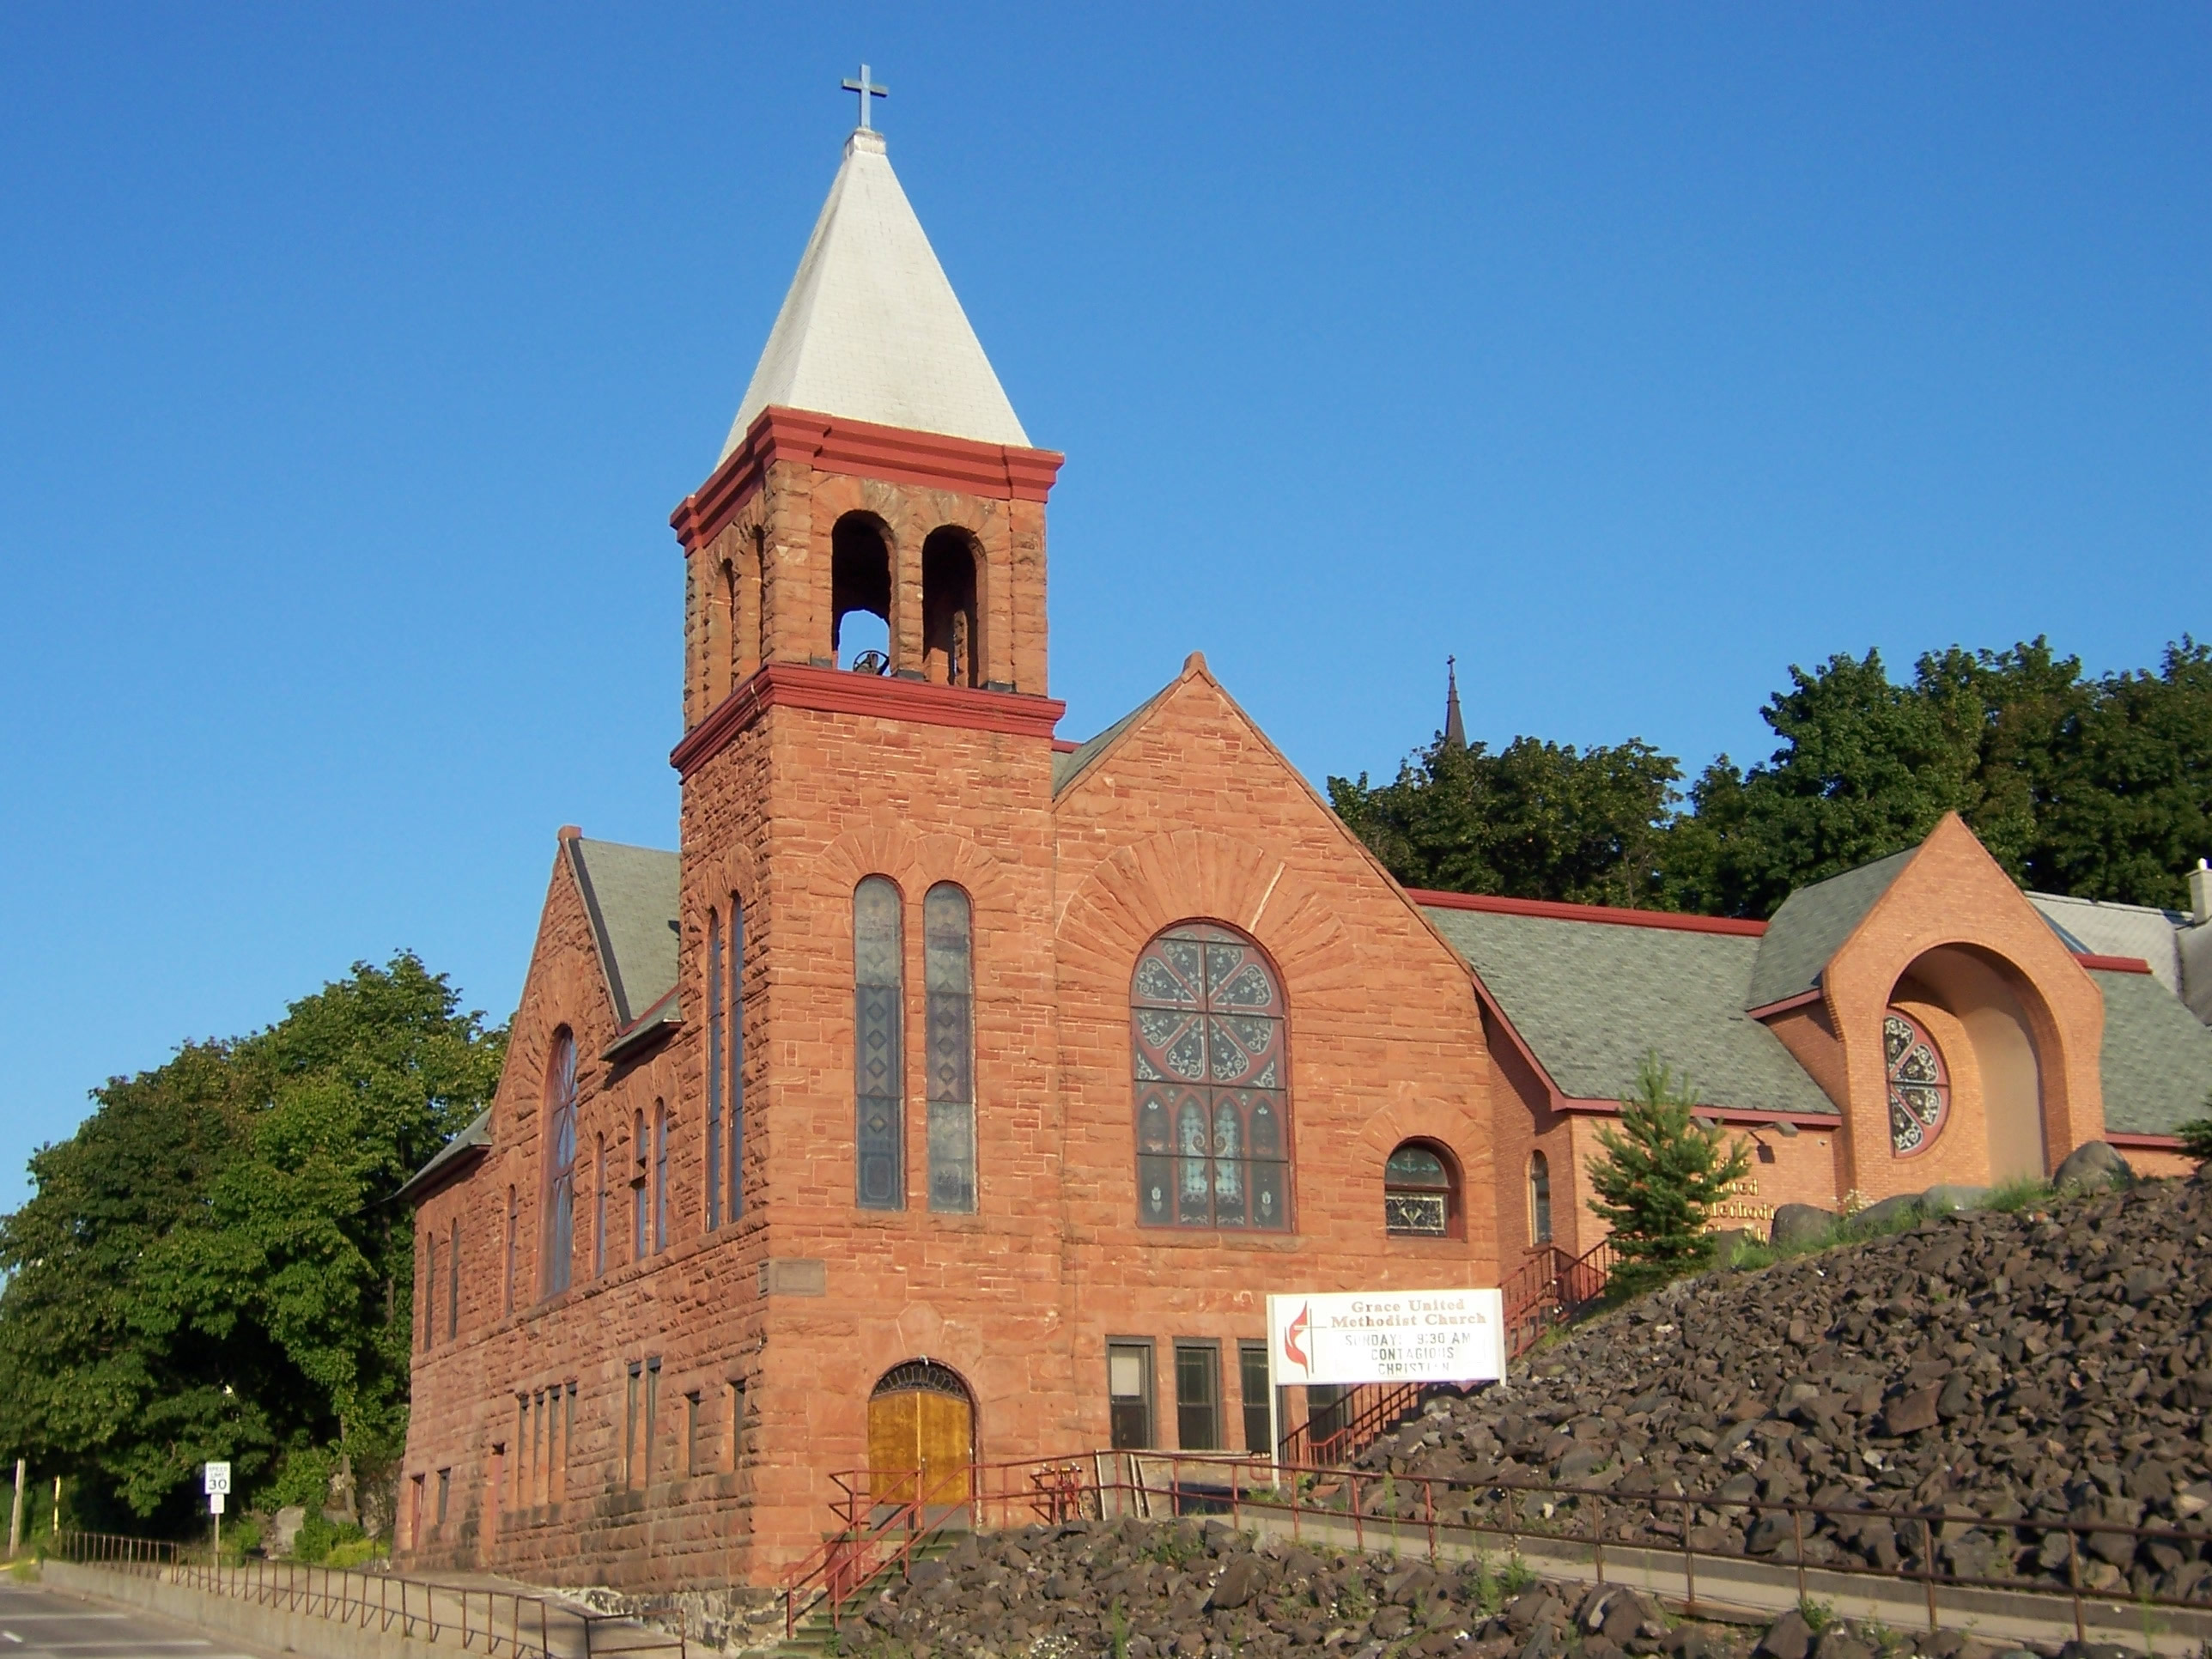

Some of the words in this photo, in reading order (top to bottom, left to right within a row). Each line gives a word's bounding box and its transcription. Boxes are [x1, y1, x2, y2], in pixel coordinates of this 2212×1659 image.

[1700, 1178, 1759, 1195] nited
[1698, 1201, 1775, 1220] Methodi
[1351, 1301, 1401, 1313] Grace
[1408, 1298, 1465, 1311] United
[1331, 1315, 1417, 1328] Methodist
[1425, 1312, 1486, 1325] Church
[1417, 1333, 1445, 1345] 9:30
[1451, 1333, 1471, 1345] AM
[1371, 1346, 1455, 1361] CONTAGIOUS
[1378, 1362, 1449, 1376] CHRISTIN
[209, 1479, 227, 1490] 30
